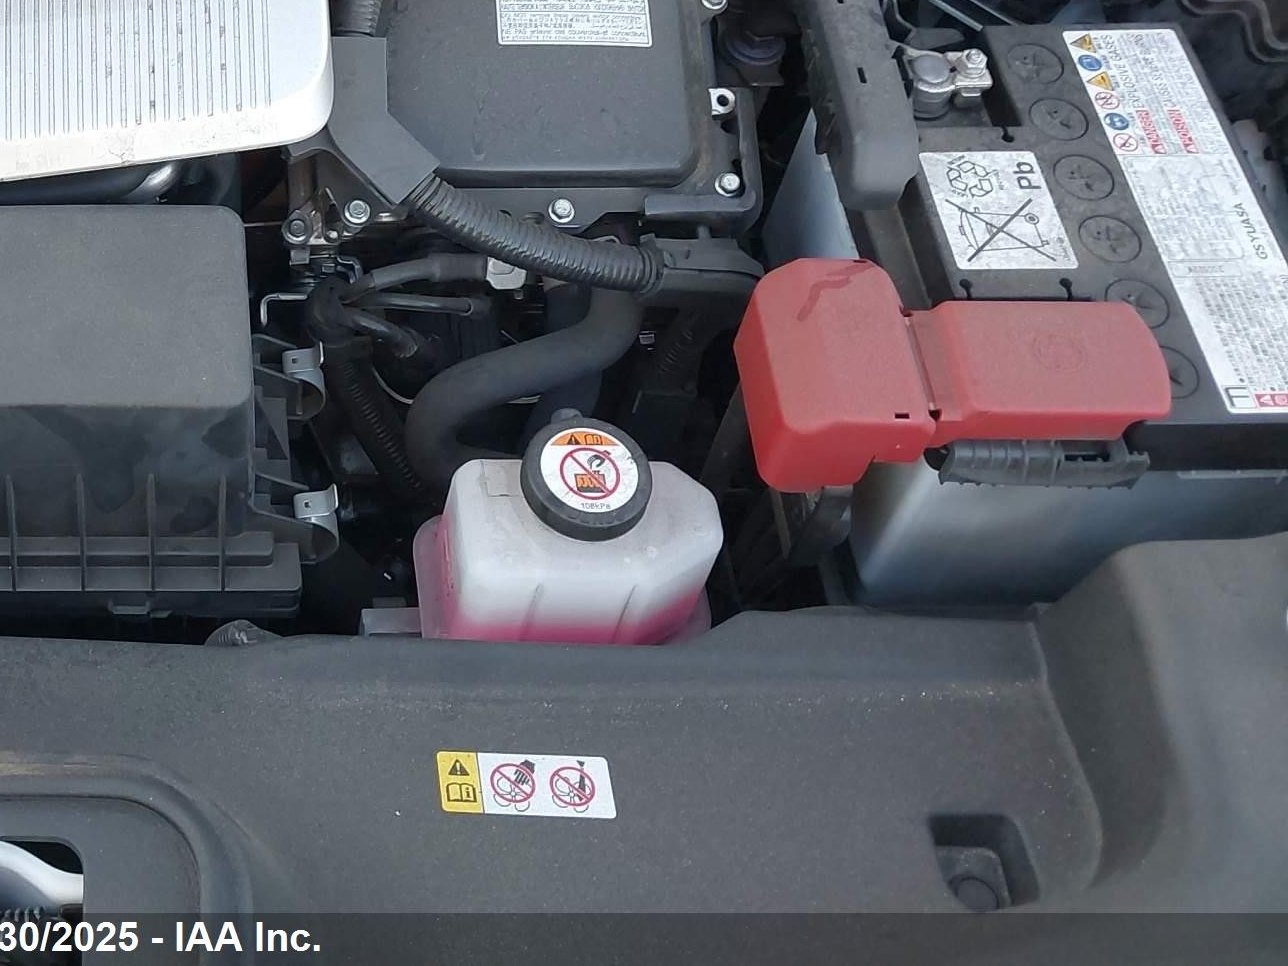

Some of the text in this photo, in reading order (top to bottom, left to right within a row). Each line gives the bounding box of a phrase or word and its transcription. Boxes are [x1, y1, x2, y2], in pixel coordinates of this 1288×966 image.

[1099, 34, 1122, 61] GASES
[1113, 64, 1144, 107] EXPLOSIVE
[1134, 110, 1162, 143] DANGER
[1166, 110, 1194, 143] POISON
[1013, 162, 1041, 189] Pb
